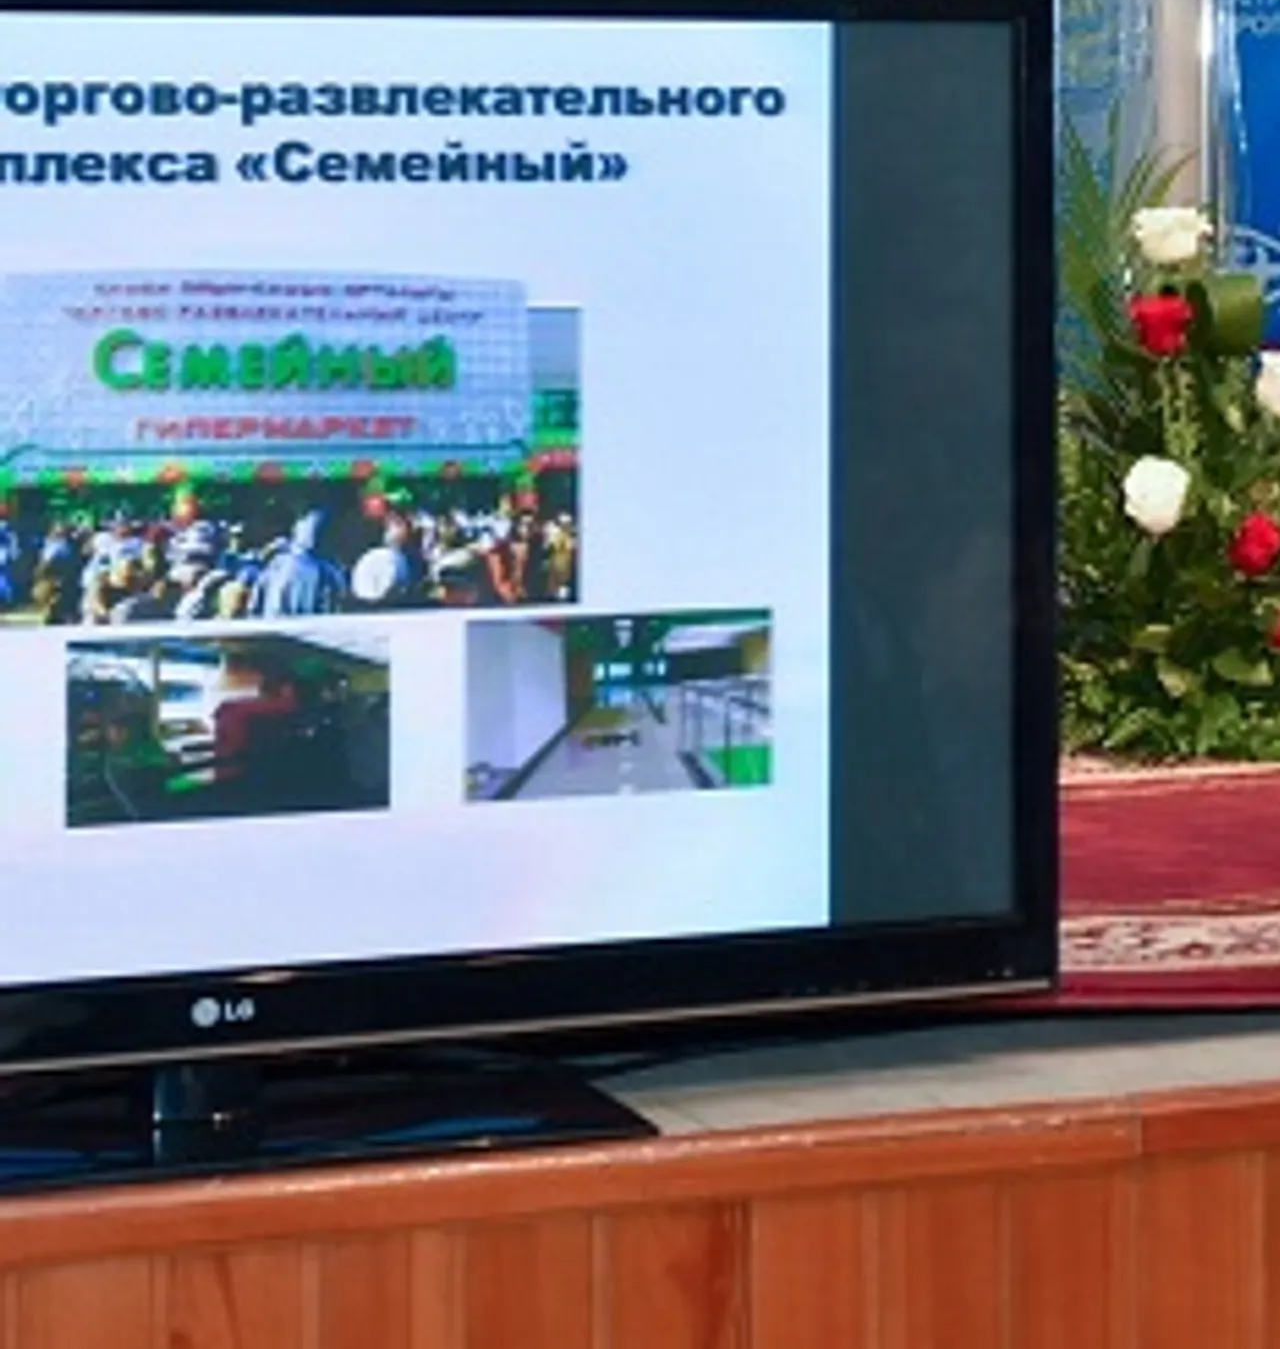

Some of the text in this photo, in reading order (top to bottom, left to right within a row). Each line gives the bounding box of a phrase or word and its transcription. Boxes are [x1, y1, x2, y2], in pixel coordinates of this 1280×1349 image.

[0, 80, 786, 128] оргово-развлекательного
[236, 139, 628, 183] «Семейный»
[224, 998, 256, 1022] LG
